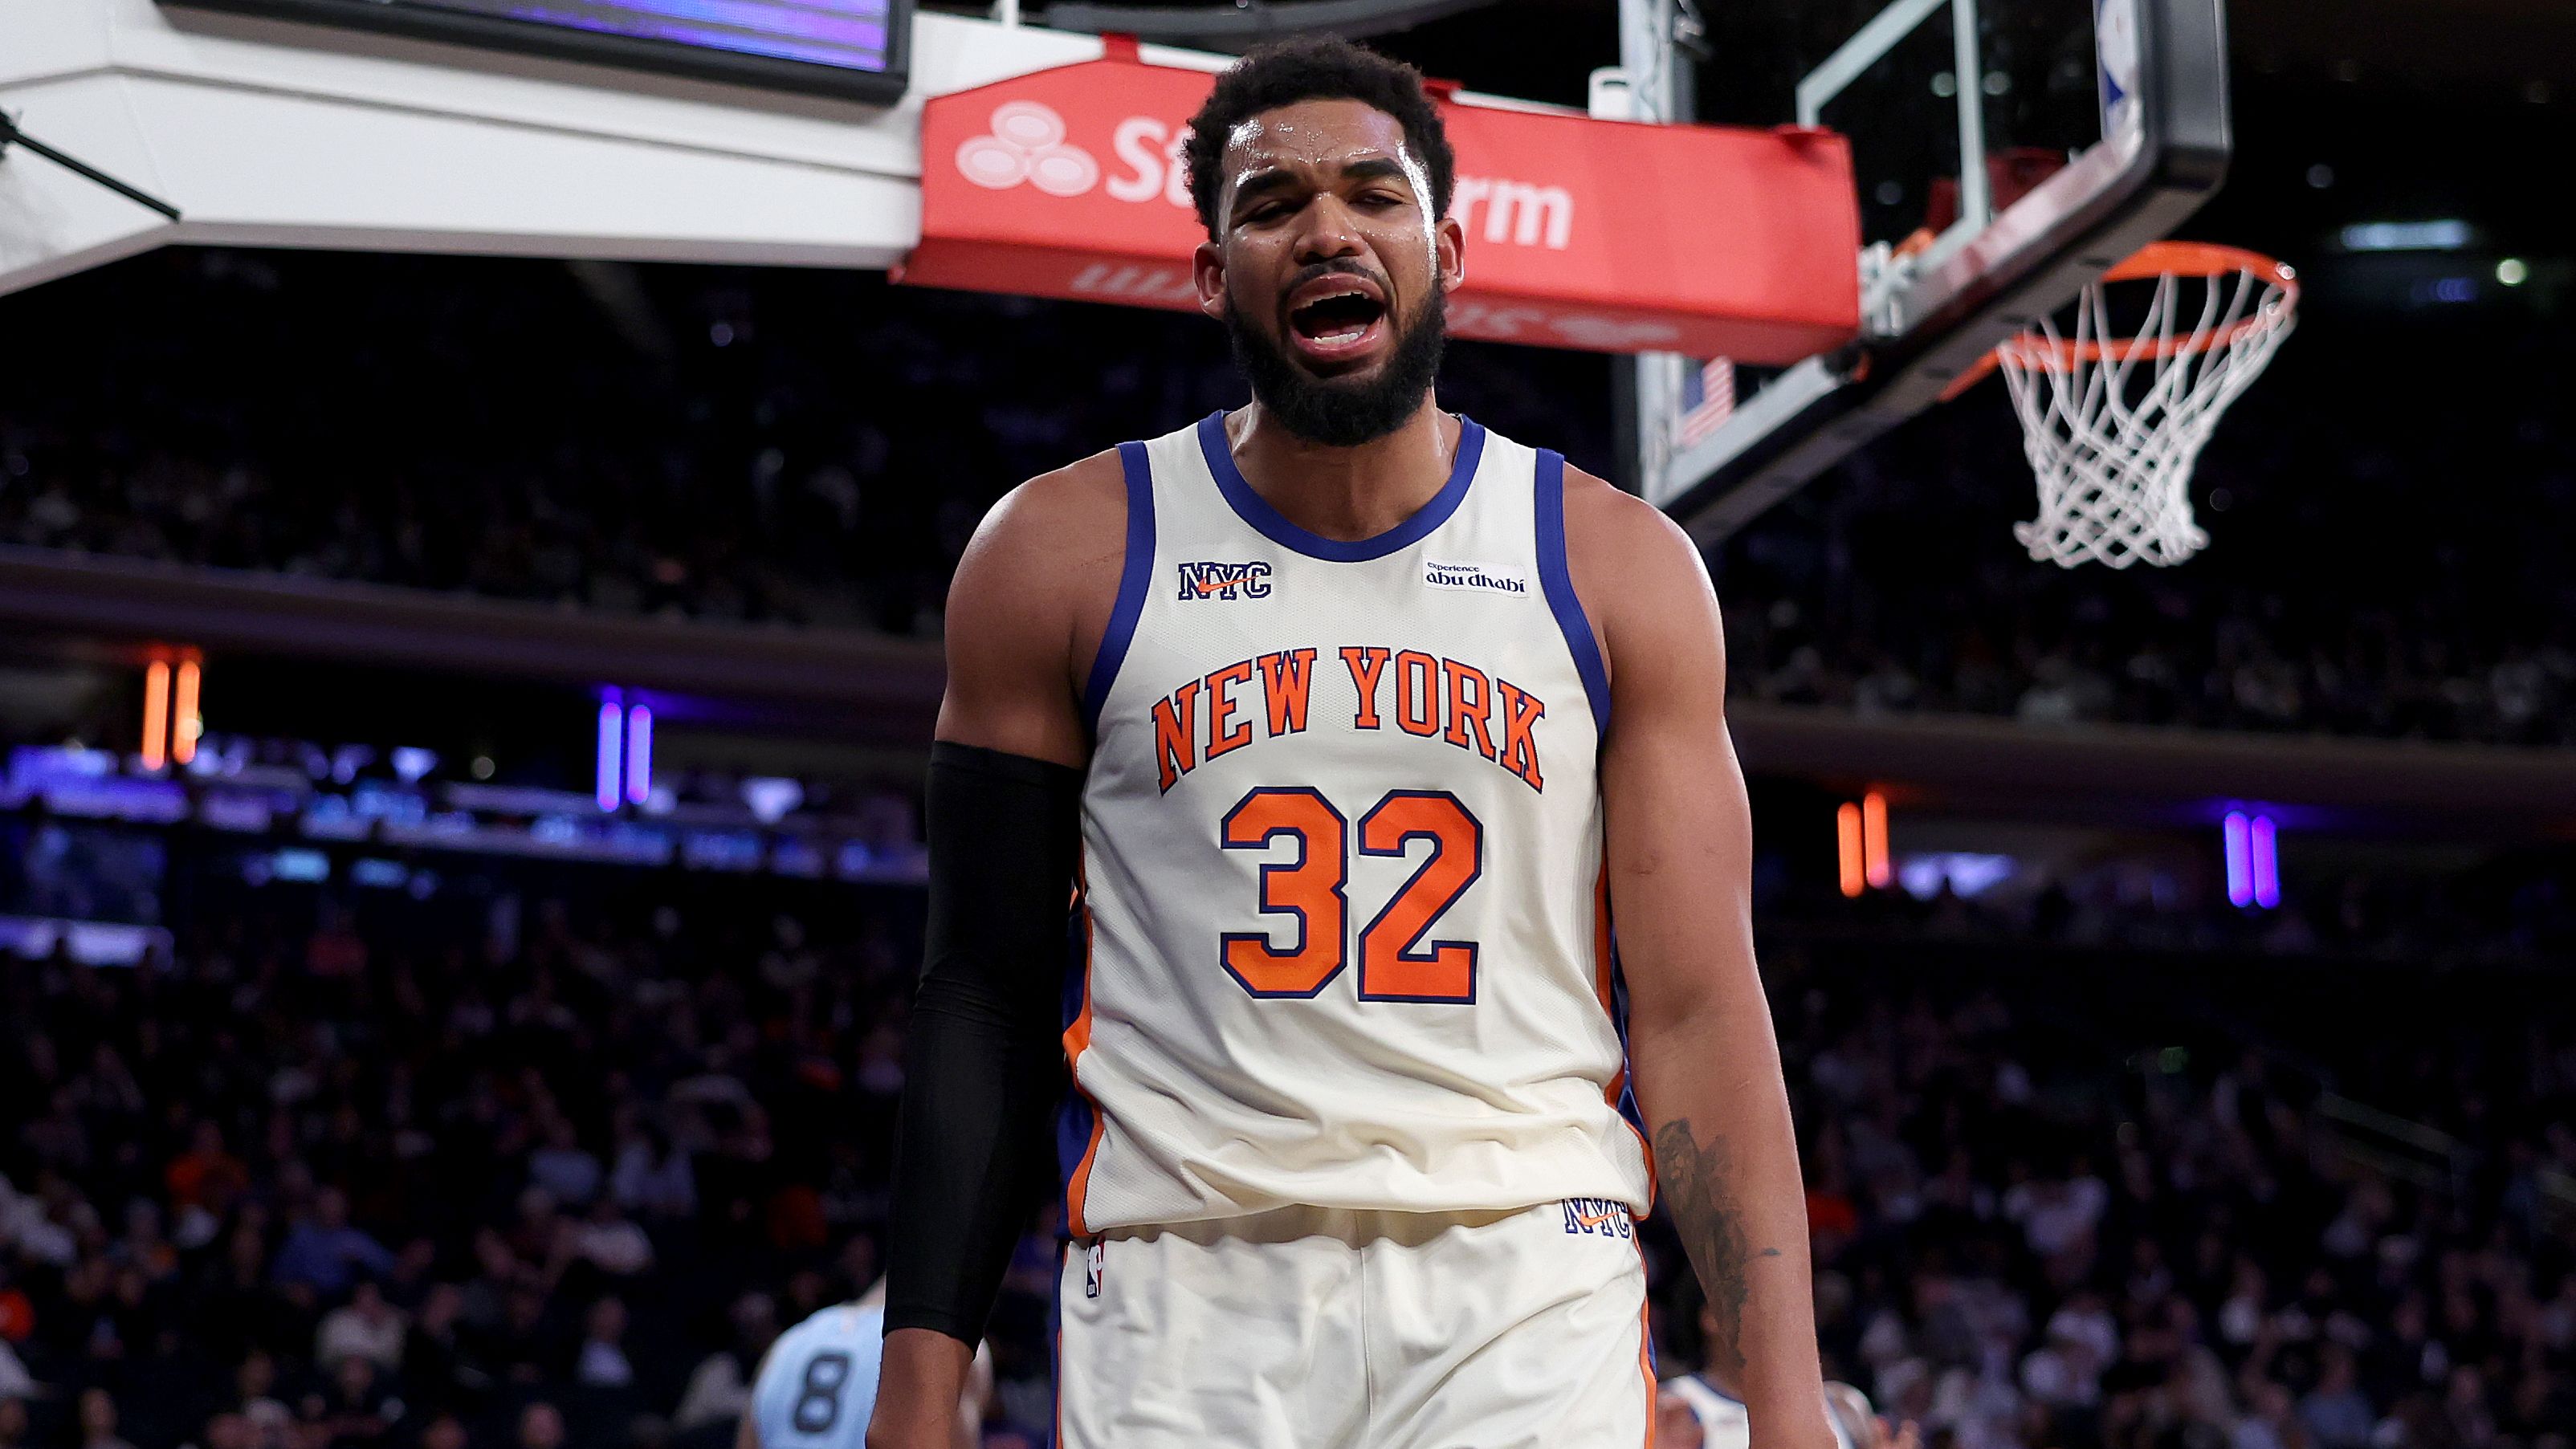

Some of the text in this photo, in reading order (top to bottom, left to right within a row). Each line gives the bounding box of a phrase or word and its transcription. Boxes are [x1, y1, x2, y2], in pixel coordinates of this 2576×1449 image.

[1107, 116, 1573, 250] St rm
[1178, 561, 1272, 600] NYC
[1426, 572, 1525, 592] abu dhabi
[1427, 562, 1480, 572] experience
[1151, 646, 1545, 796] NEW YORK
[1221, 786, 1483, 1004] 32
[1561, 1198, 1631, 1239] NYC
[793, 1352, 850, 1434] 8
